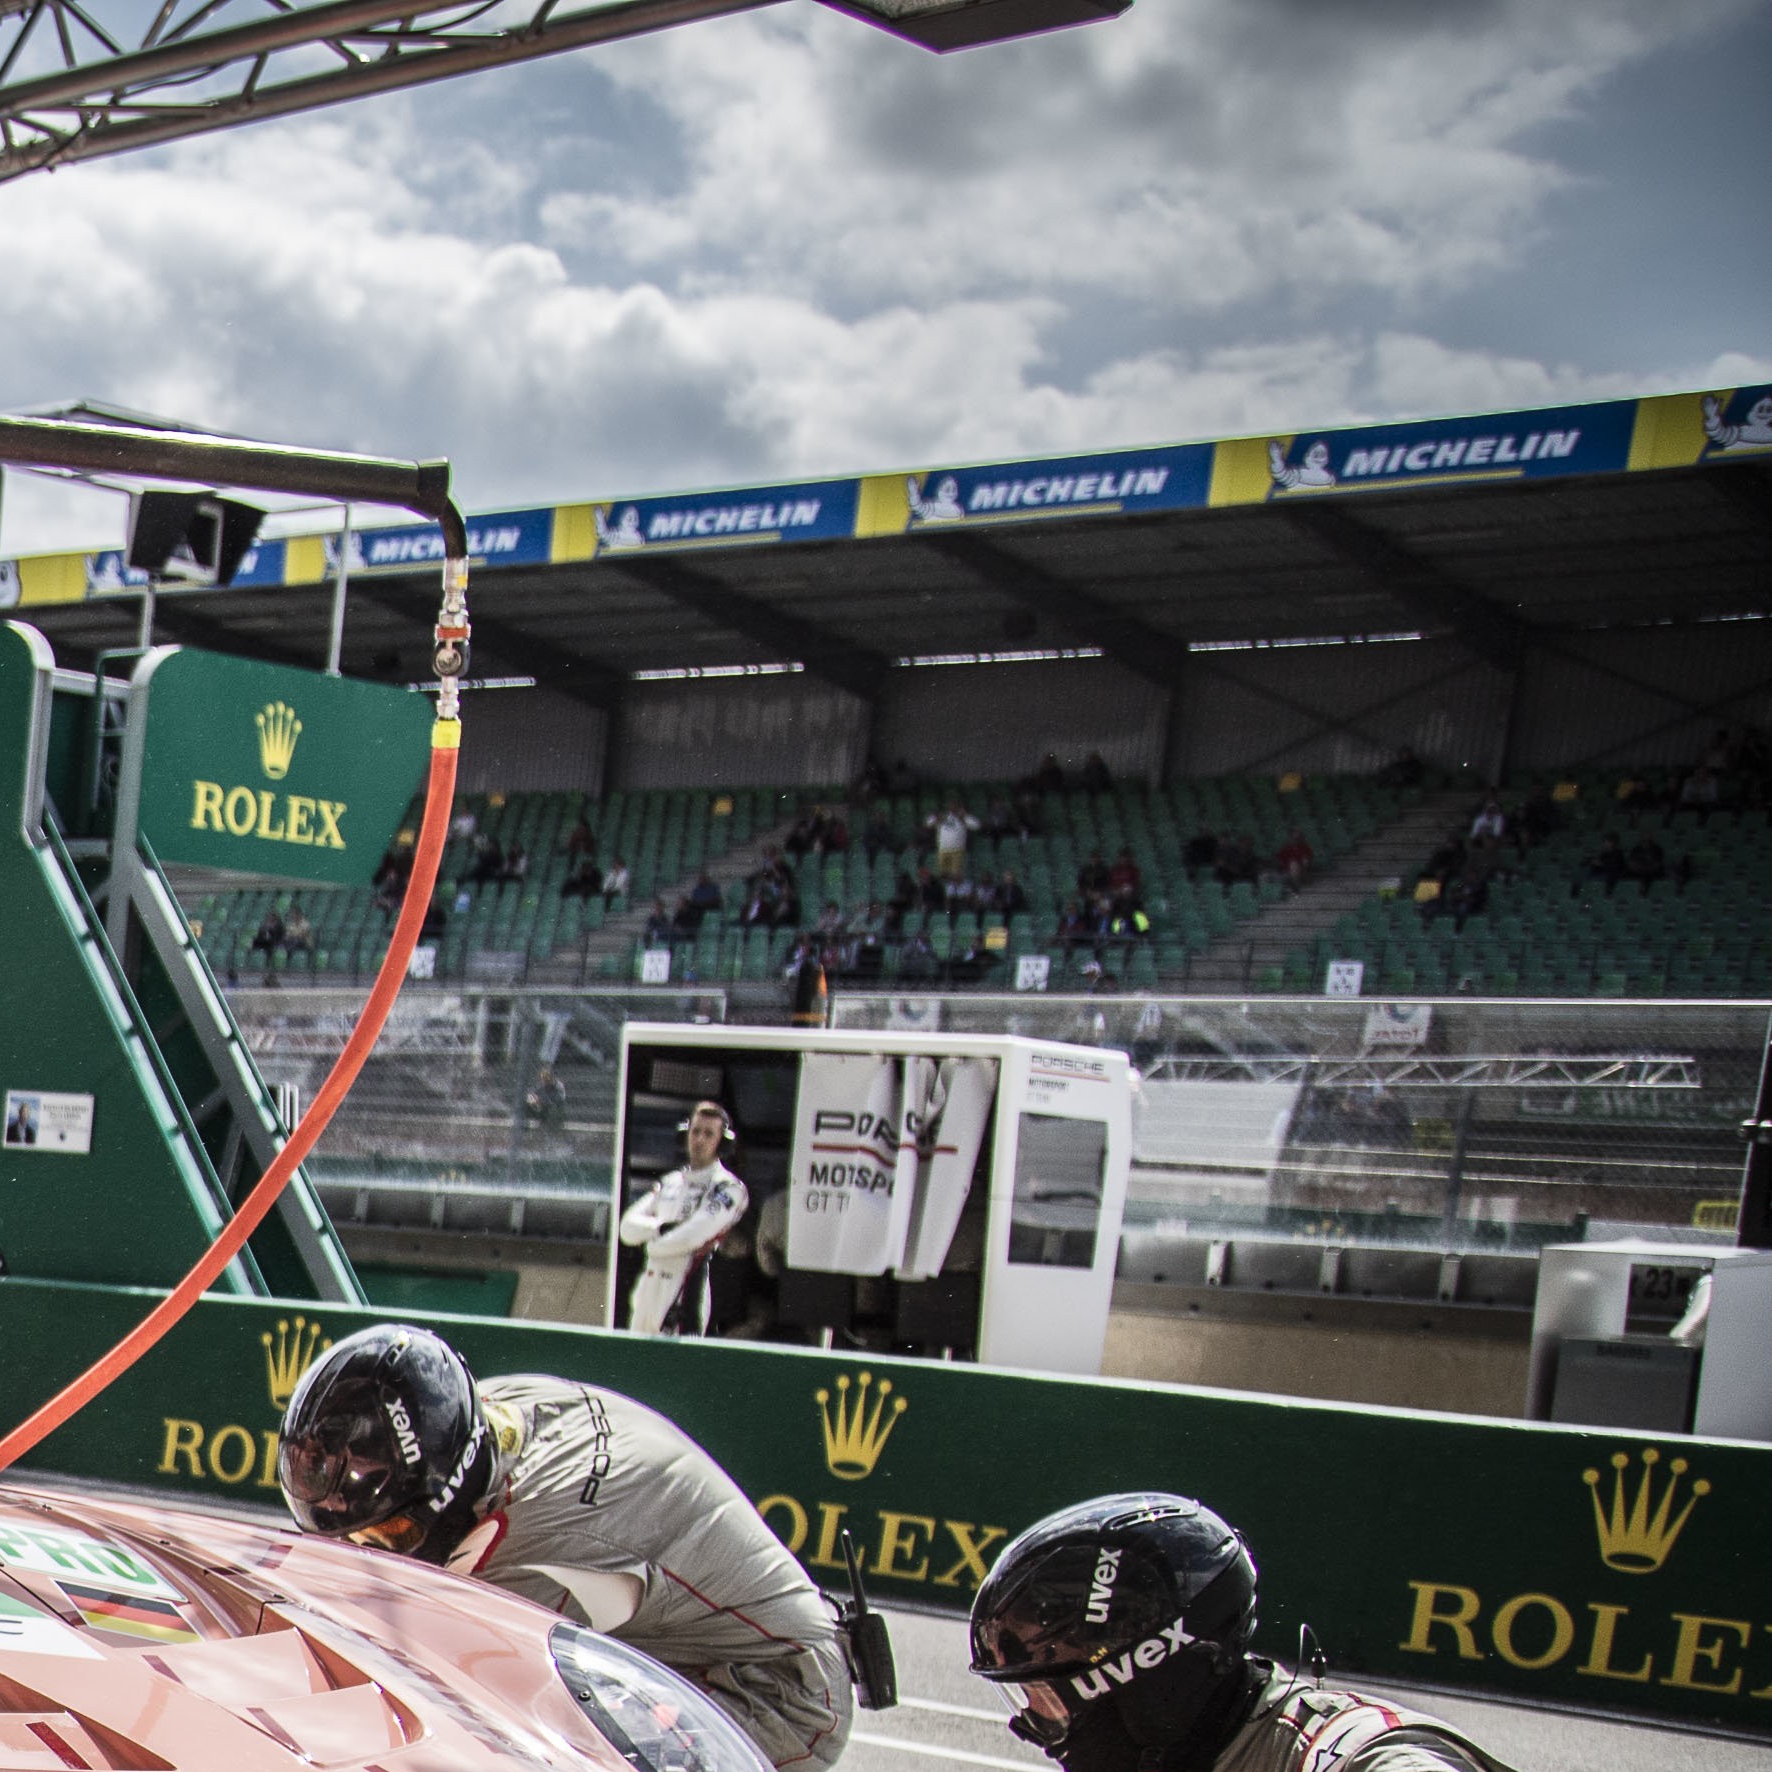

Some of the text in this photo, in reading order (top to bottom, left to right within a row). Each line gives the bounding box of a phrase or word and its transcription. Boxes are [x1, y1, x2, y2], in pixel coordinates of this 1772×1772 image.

[1344, 428, 1581, 478] MICHELIN
[649, 499, 822, 538] MICHELIN
[970, 467, 1169, 512] MICHELIN
[371, 527, 520, 564] MICHLIN
[191, 779, 348, 851] ROLEX
[1030, 1055, 1105, 1075] PORSCHE
[157, 1416, 282, 1488] ROL
[385, 1397, 423, 1466] uvex
[429, 1414, 487, 1513] uvex
[761, 1494, 1008, 1592] OLEX
[1085, 1548, 1123, 1624] uvex
[1070, 1616, 1196, 1700] uvex
[1399, 1580, 1772, 1700] ROLE
